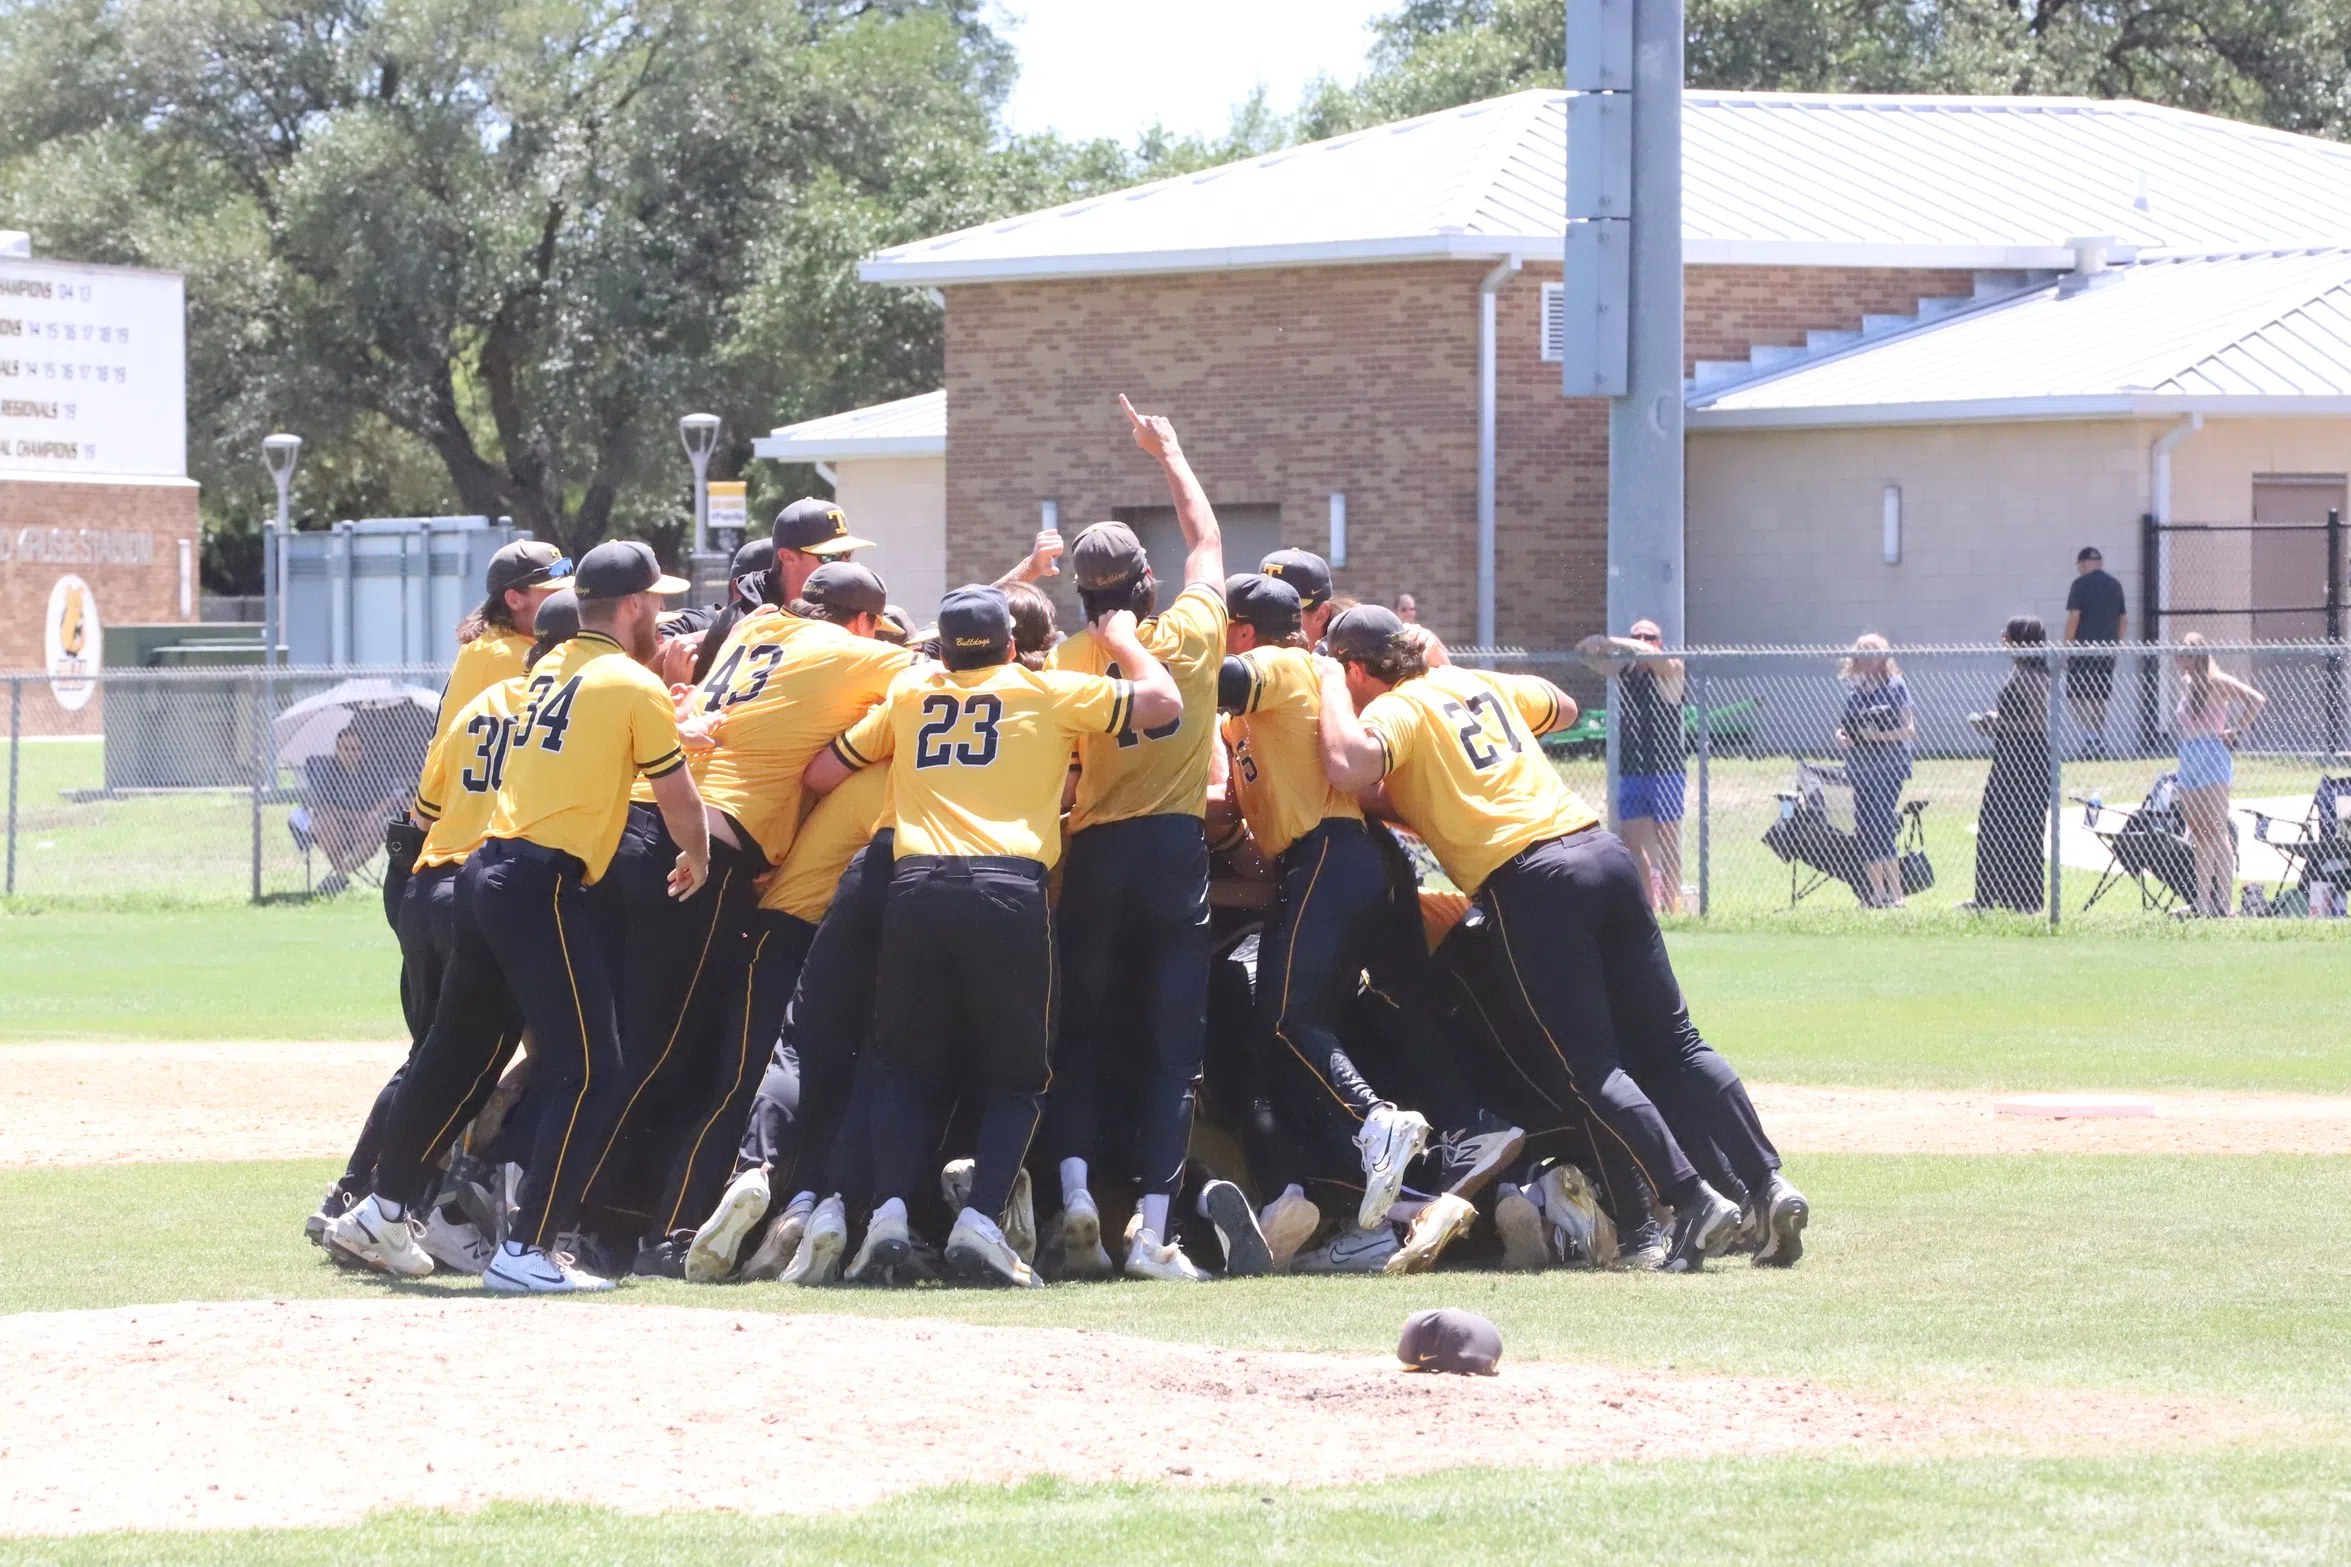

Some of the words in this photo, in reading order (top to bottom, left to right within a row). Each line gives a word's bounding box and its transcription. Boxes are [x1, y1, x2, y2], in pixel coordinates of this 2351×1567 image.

[17, 440, 78, 460] CHAMPIONS
[826, 509, 848, 534] T
[956, 637, 991, 648] Bulldogs
[512, 674, 585, 752] 34
[702, 644, 784, 713] 43
[916, 692, 1002, 770] 23
[1443, 691, 1523, 770] 27
